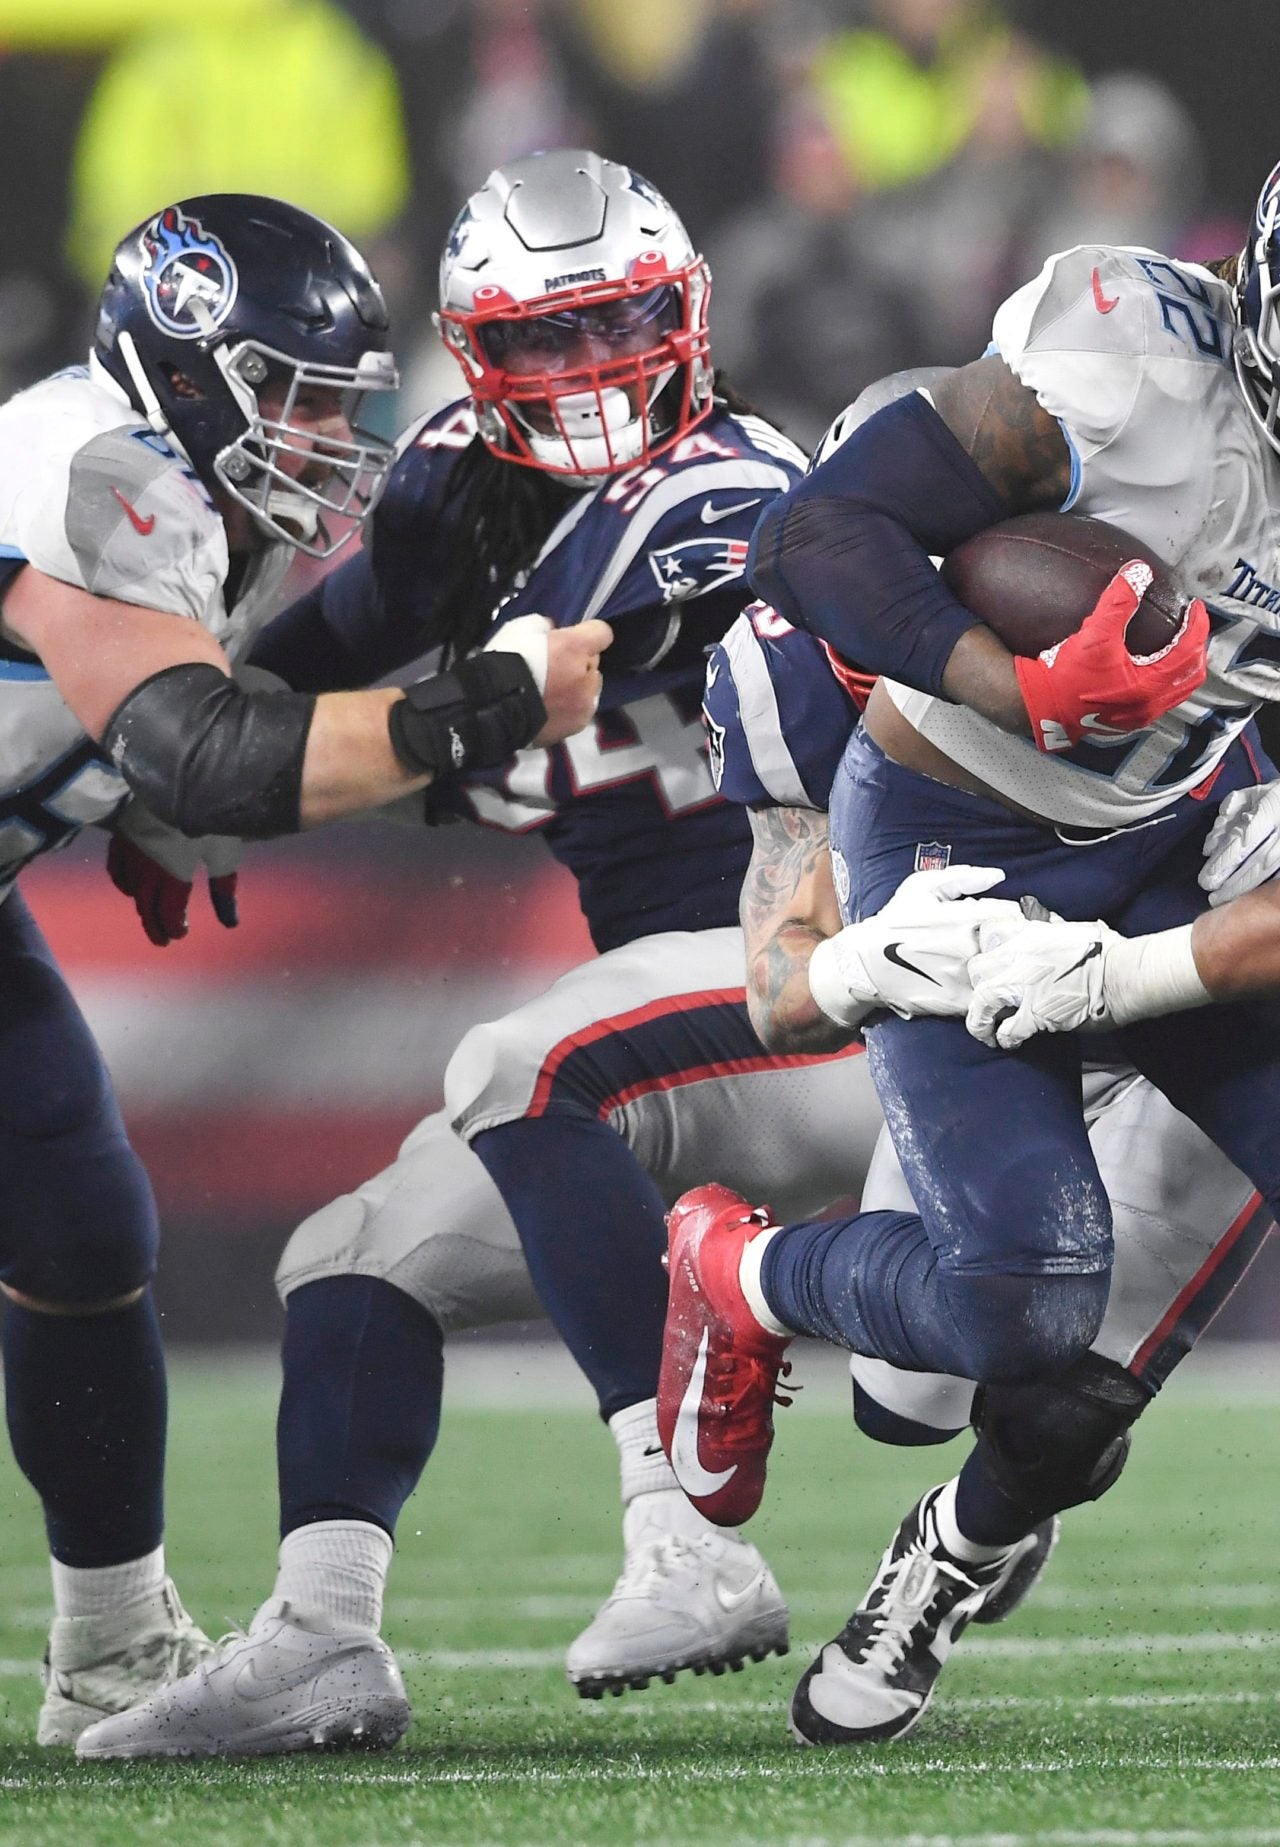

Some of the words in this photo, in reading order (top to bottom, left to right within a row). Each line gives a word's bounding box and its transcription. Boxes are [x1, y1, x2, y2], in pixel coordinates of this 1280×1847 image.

[544, 267, 607, 293] PATRIOTS
[1130, 256, 1226, 361] 22
[603, 430, 740, 516] 54
